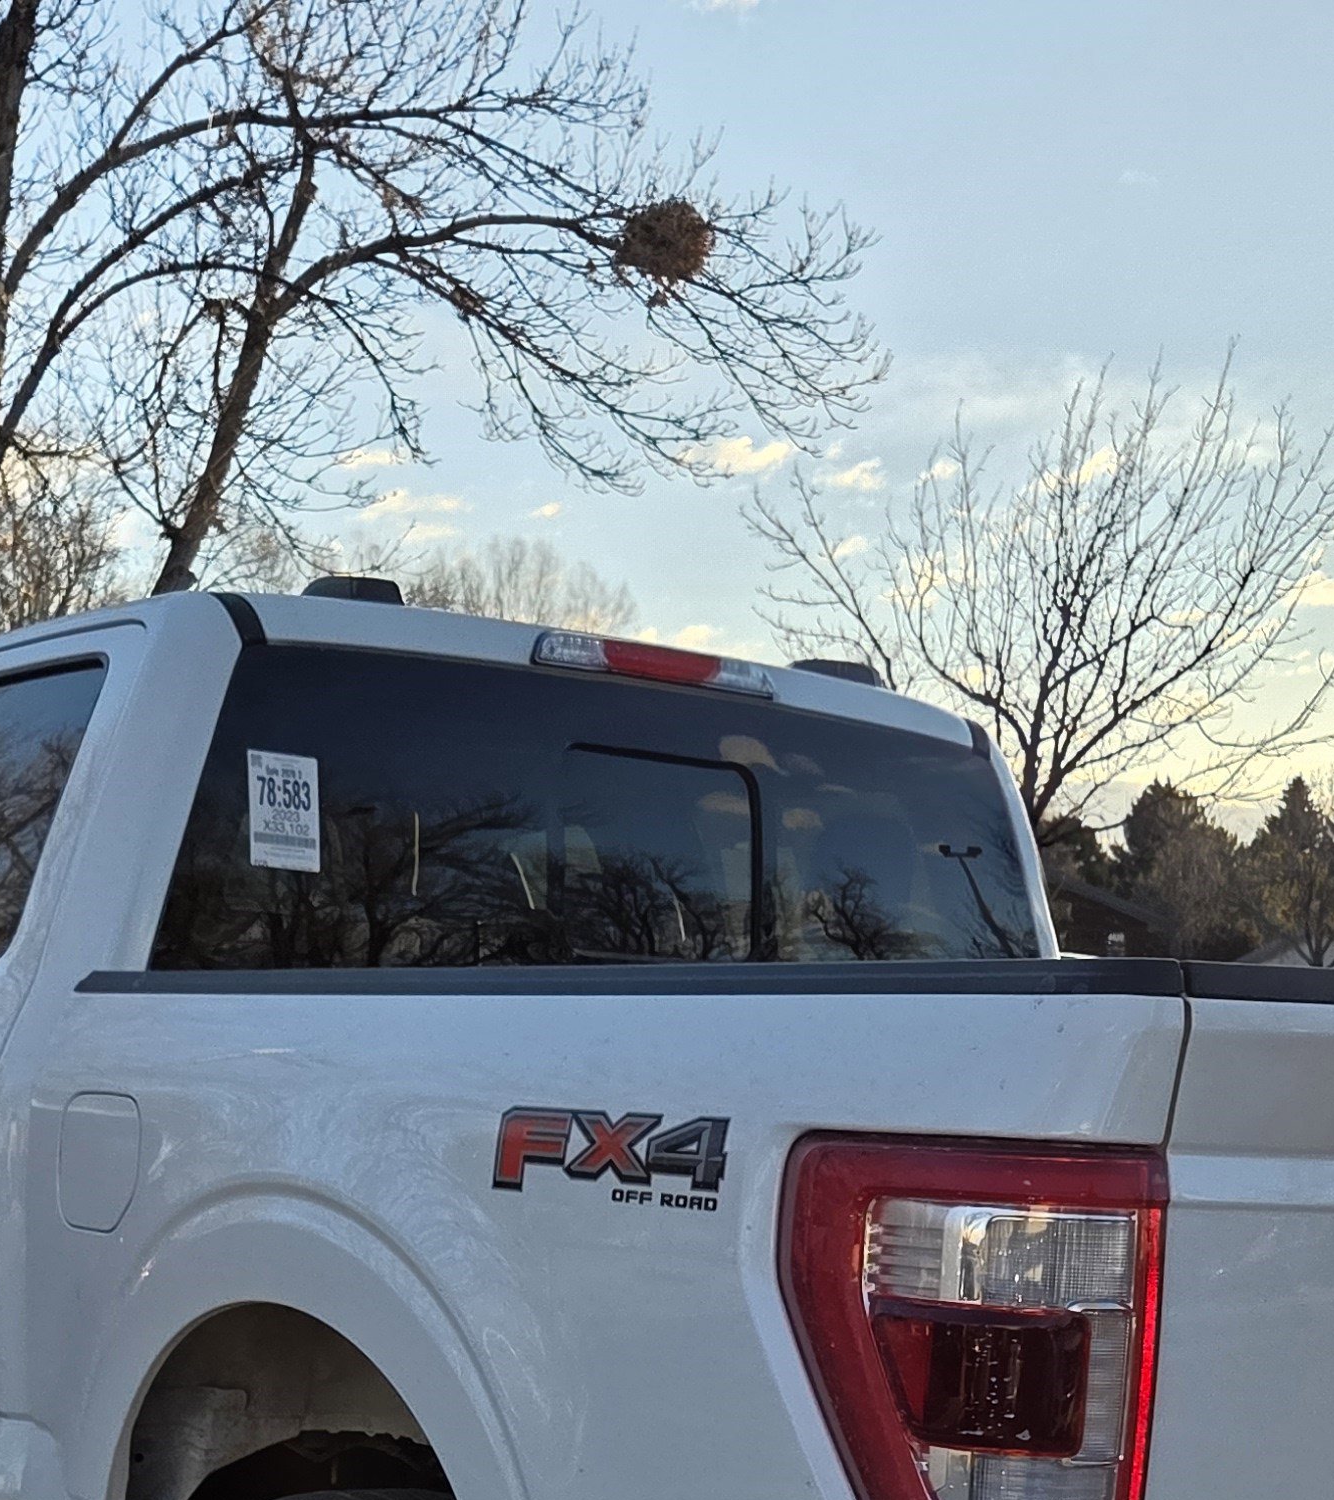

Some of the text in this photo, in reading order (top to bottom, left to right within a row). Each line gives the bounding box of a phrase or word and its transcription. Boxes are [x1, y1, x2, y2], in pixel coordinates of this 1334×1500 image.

[256, 775, 311, 812] 78:583
[272, 808, 301, 823] 2023
[492, 1105, 732, 1194] FX4
[611, 1188, 719, 1211] OFF ROAD
